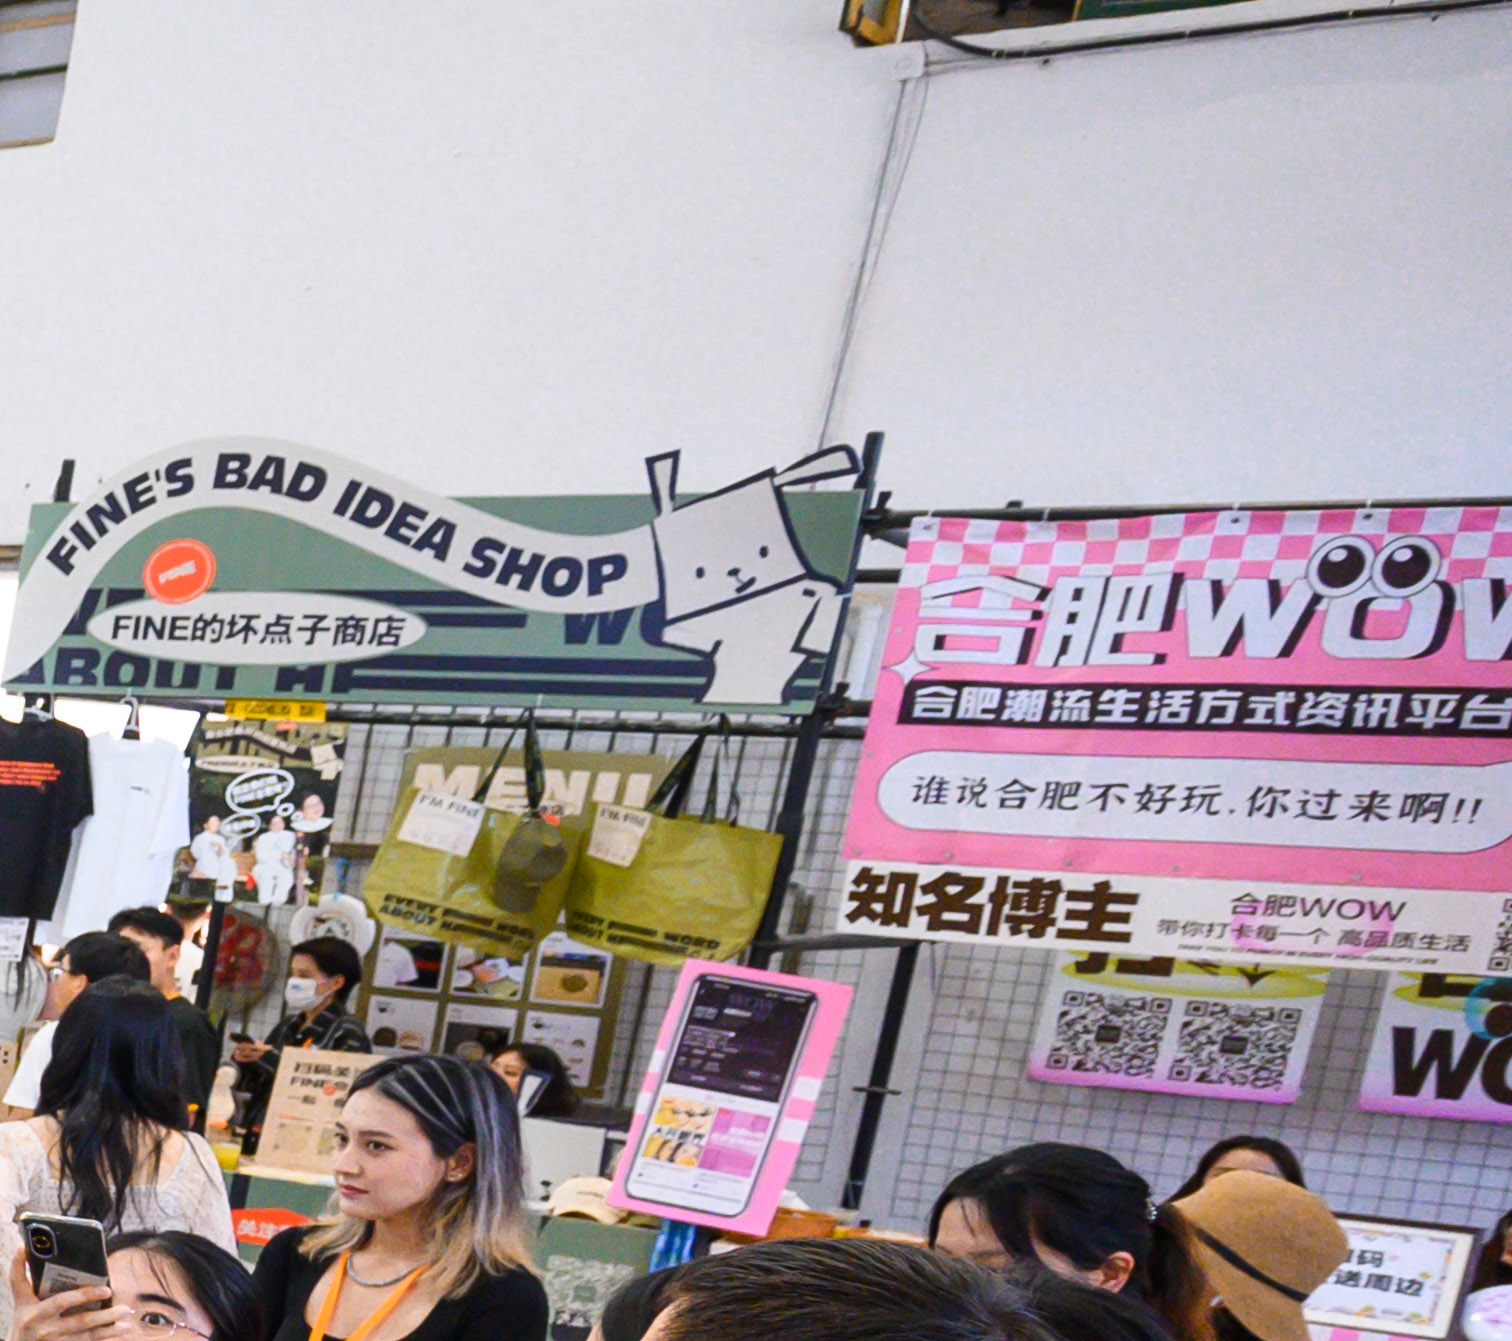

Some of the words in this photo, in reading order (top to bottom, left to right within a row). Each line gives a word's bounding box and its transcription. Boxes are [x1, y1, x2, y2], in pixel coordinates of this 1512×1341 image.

[46, 457, 195, 577] FINE'S
[213, 452, 328, 502] BAD
[333, 479, 457, 562] IDEA
[462, 537, 627, 597] SHOP
[111, 613, 406, 647] FINE的坏点子商店
[846, 866, 1139, 943] 知名博主
[1230, 892, 1408, 921] 合肥WOW
